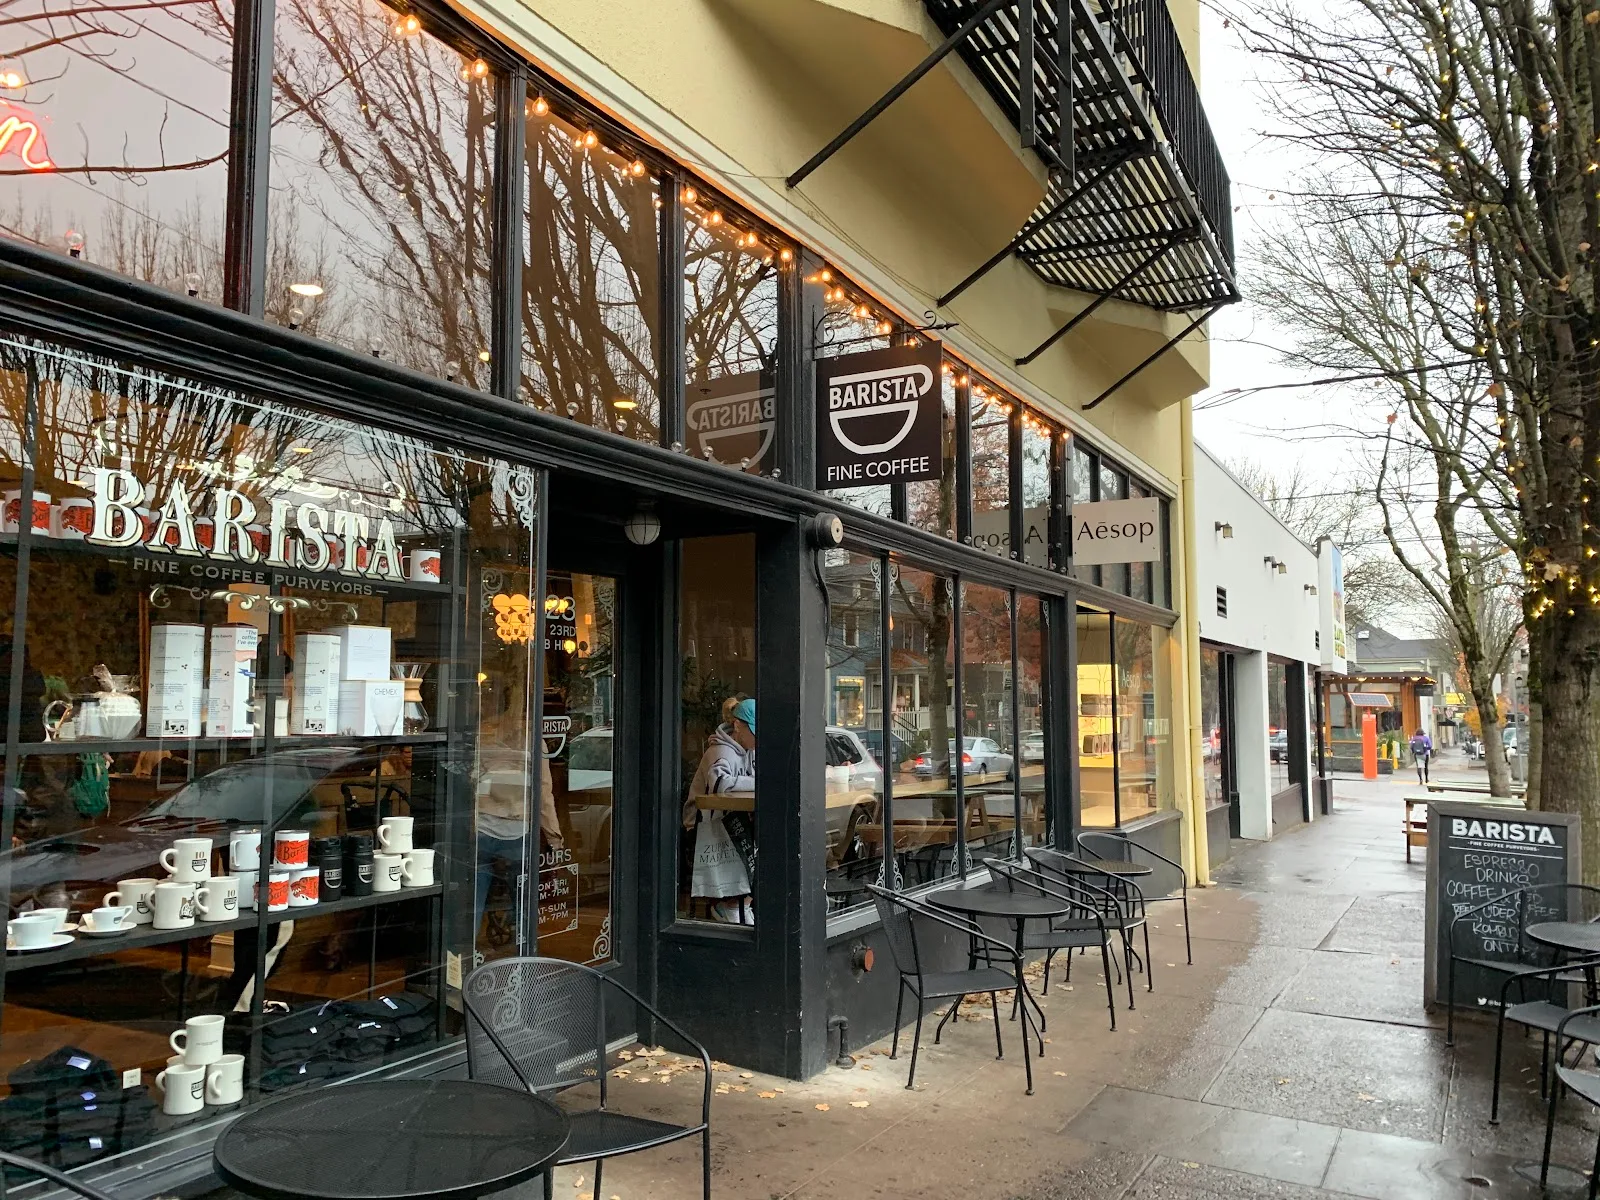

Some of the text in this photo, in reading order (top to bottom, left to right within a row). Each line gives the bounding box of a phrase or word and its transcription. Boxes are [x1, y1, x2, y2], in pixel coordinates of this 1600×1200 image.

[829, 376, 918, 410] BARISTA
[827, 456, 930, 481] FINE COFFEE
[84, 466, 406, 583] BARISTA
[1077, 520, 1154, 543] Aēsop
[133, 557, 372, 596] FINE COFFEE PURVEYORS
[550, 624, 576, 637] 23RD
[543, 721, 567, 732] RISTA
[1452, 819, 1556, 844] BARISTA
[536, 849, 571, 867] OURS
[1464, 854, 1539, 878] ESPRESSO
[1476, 867, 1531, 888] DRINKS
[1446, 880, 1497, 900] COFFEE
